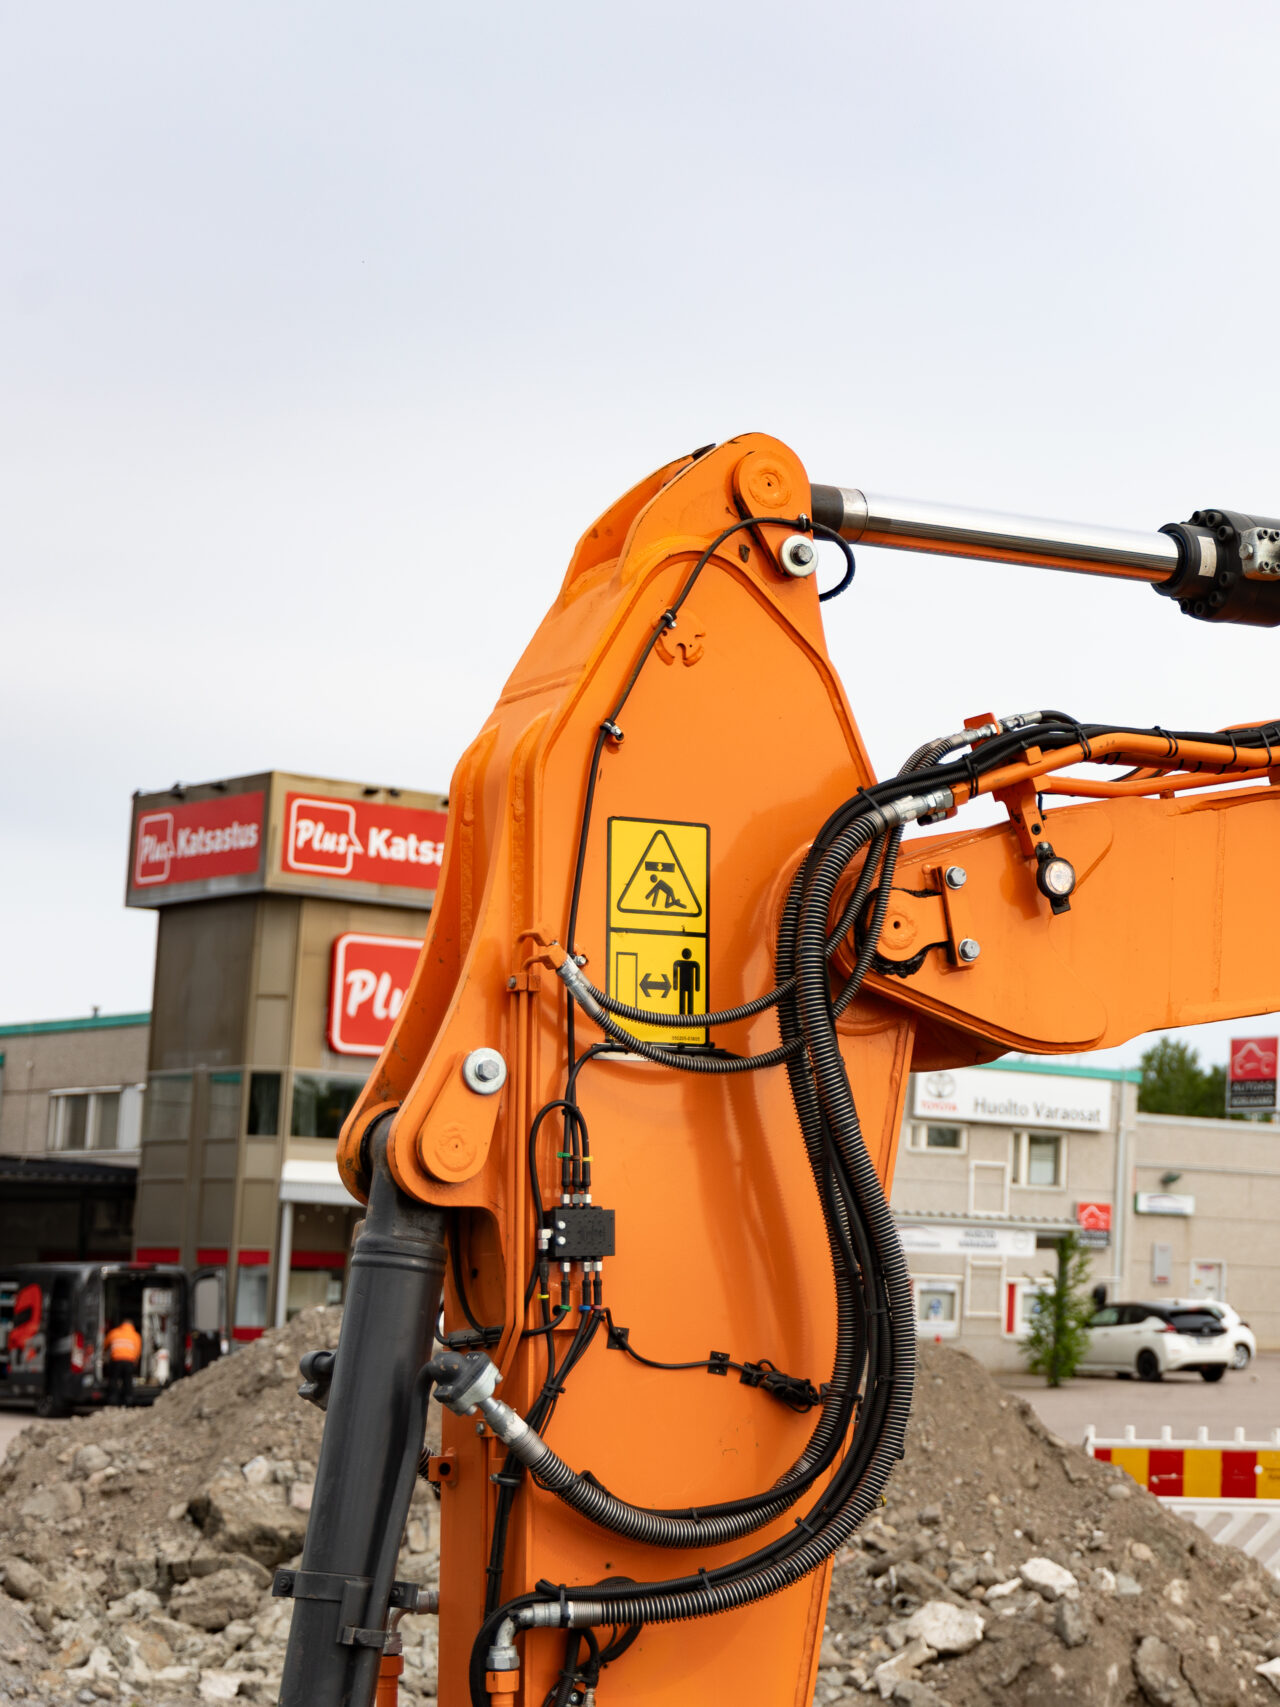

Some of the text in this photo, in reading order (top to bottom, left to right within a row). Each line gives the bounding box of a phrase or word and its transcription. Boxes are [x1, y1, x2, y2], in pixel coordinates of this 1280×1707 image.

[141, 822, 258, 864] Plus Katsastus
[297, 818, 444, 866] Plus Katsa
[973, 1097, 1101, 1123] Huolto Varaosat
